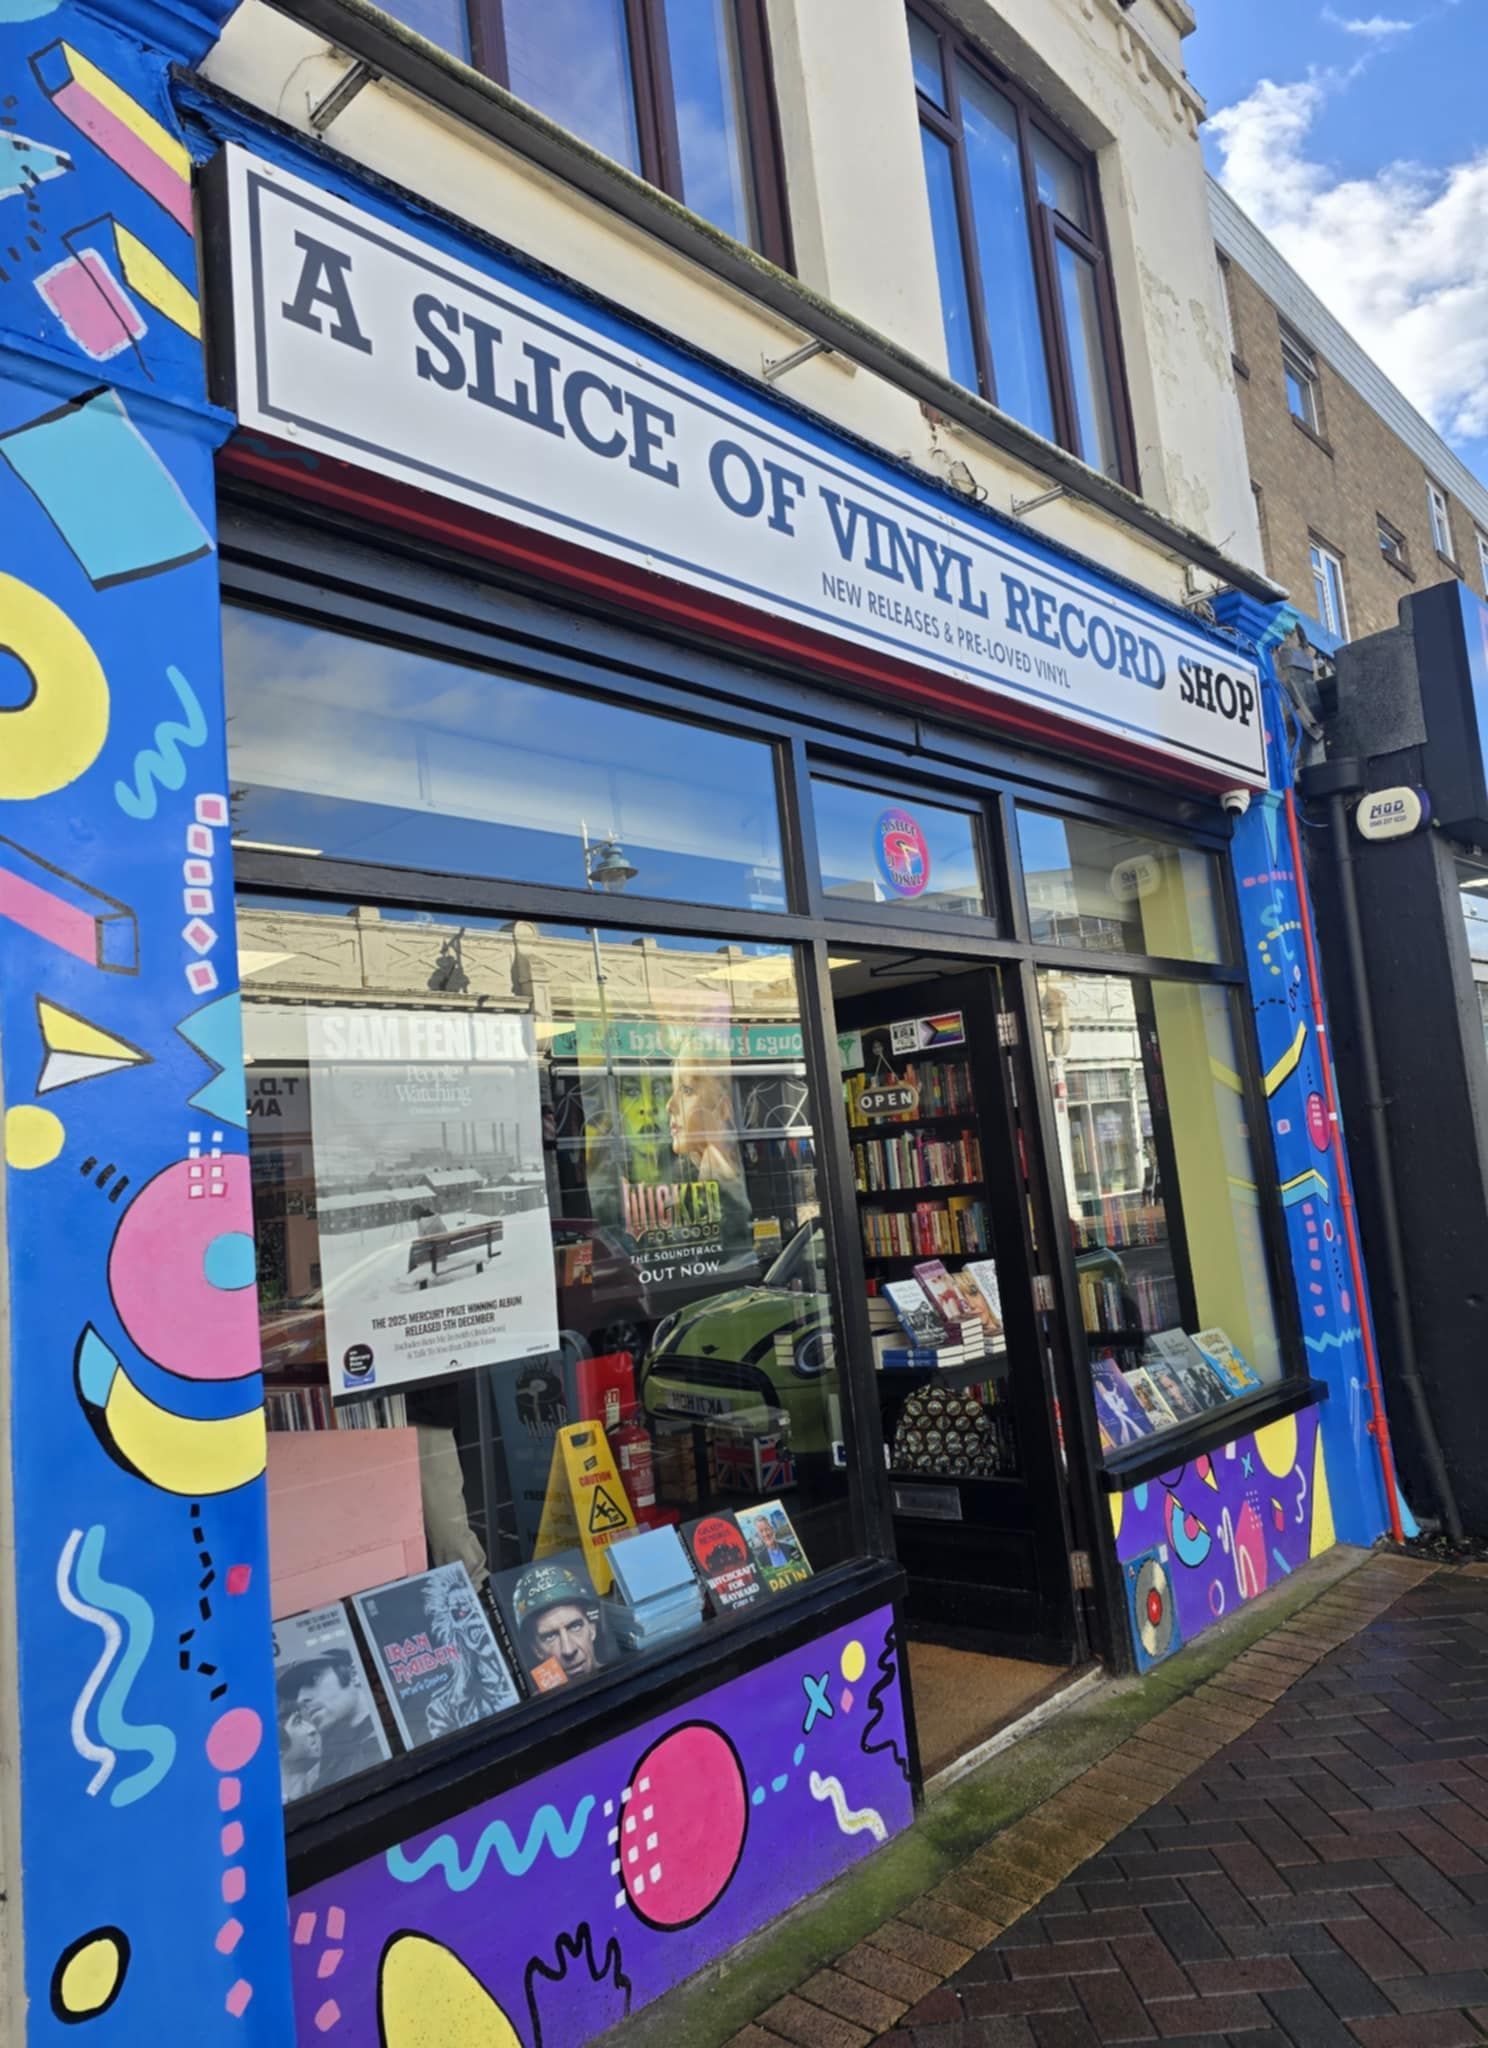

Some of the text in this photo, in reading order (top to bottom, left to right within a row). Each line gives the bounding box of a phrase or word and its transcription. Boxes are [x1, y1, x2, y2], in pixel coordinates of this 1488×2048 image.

[282, 230, 1255, 726] A SLICE OF VINYL RECORD SHOP
[822, 572, 1071, 688] NEW RELEASES & PRE-LOVED VINYL
[322, 1016, 400, 1059] SAM
[408, 1016, 528, 1060] FENDER
[395, 1082, 472, 1105] Watching
[861, 1091, 913, 1109] OPEN
[621, 1177, 722, 1242] WICKED
[647, 1224, 720, 1241] FOR GOOD
[630, 1244, 723, 1264] THE SOUNDTRACK
[639, 1259, 720, 1284] OUT NOW
[372, 1296, 522, 1330] THE 2025 MERCURY PRIZE WINNING ALBUM
[405, 1322, 441, 1337] RELEASED
[458, 1312, 496, 1329] DECEMBER
[579, 1471, 612, 1487] CAUTION
[706, 1563, 757, 1589] WITCHCRAFT
[727, 1579, 745, 1591] FOR
[719, 1583, 760, 1605] WAYWARD
[384, 1632, 432, 1665] IRON
[390, 1642, 461, 1685] MAIDEN
